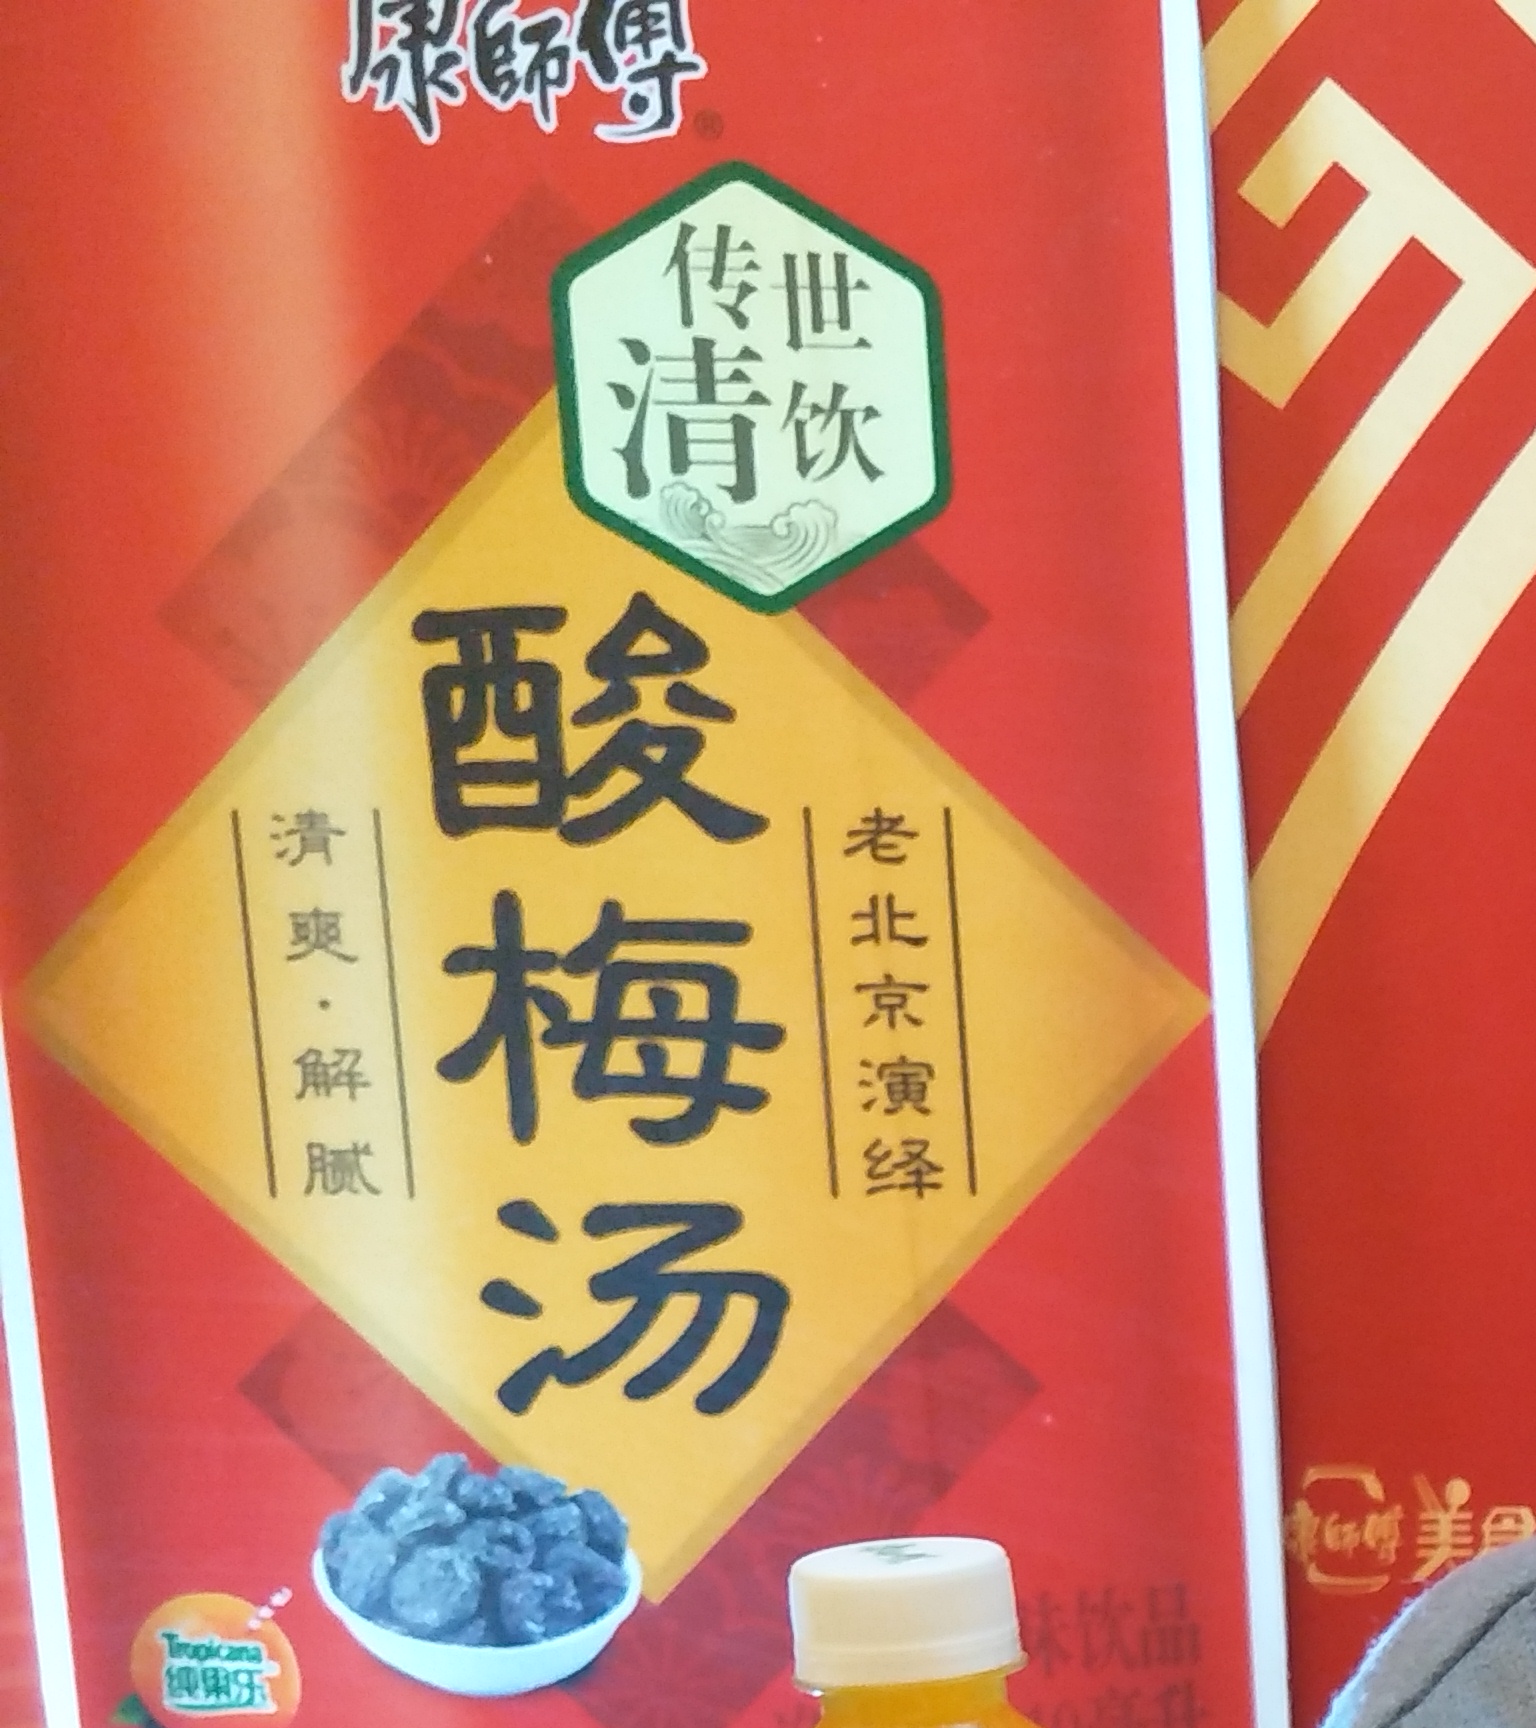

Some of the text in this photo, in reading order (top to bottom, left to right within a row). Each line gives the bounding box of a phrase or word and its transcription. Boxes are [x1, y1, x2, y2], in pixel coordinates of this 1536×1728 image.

[663, 221, 874, 356] 传世
[606, 337, 888, 505] 清饮
[413, 592, 792, 1414] 酸梅汤
[845, 808, 945, 1200] 老北京演绎
[162, 1631, 263, 1664] Tropicana
